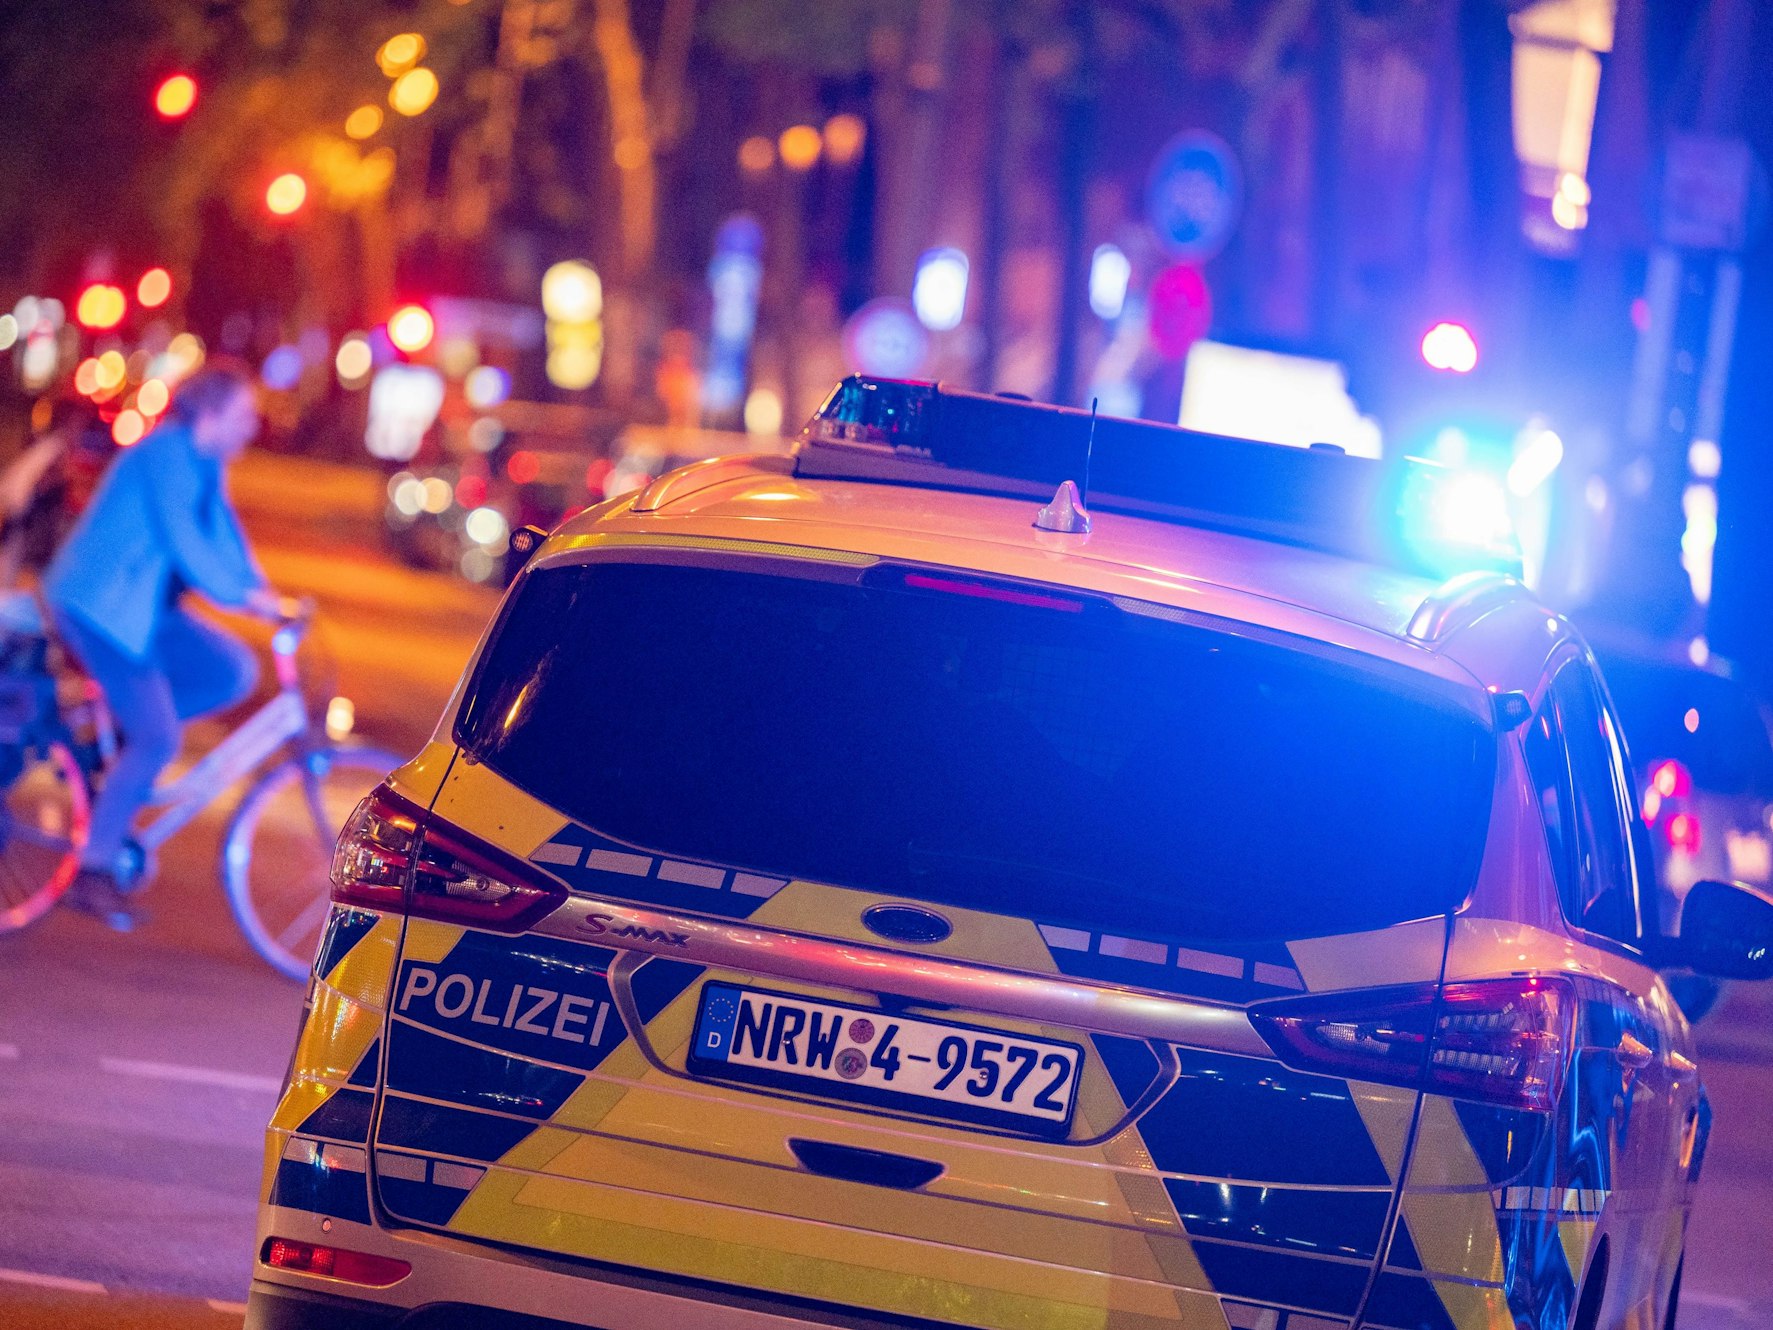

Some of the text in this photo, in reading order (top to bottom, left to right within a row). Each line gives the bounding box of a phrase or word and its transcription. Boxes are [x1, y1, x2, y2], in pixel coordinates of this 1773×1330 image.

[399, 967, 610, 1047] POLIZEI
[707, 1032, 721, 1048] D
[731, 999, 1072, 1113] NRW 4-9572
